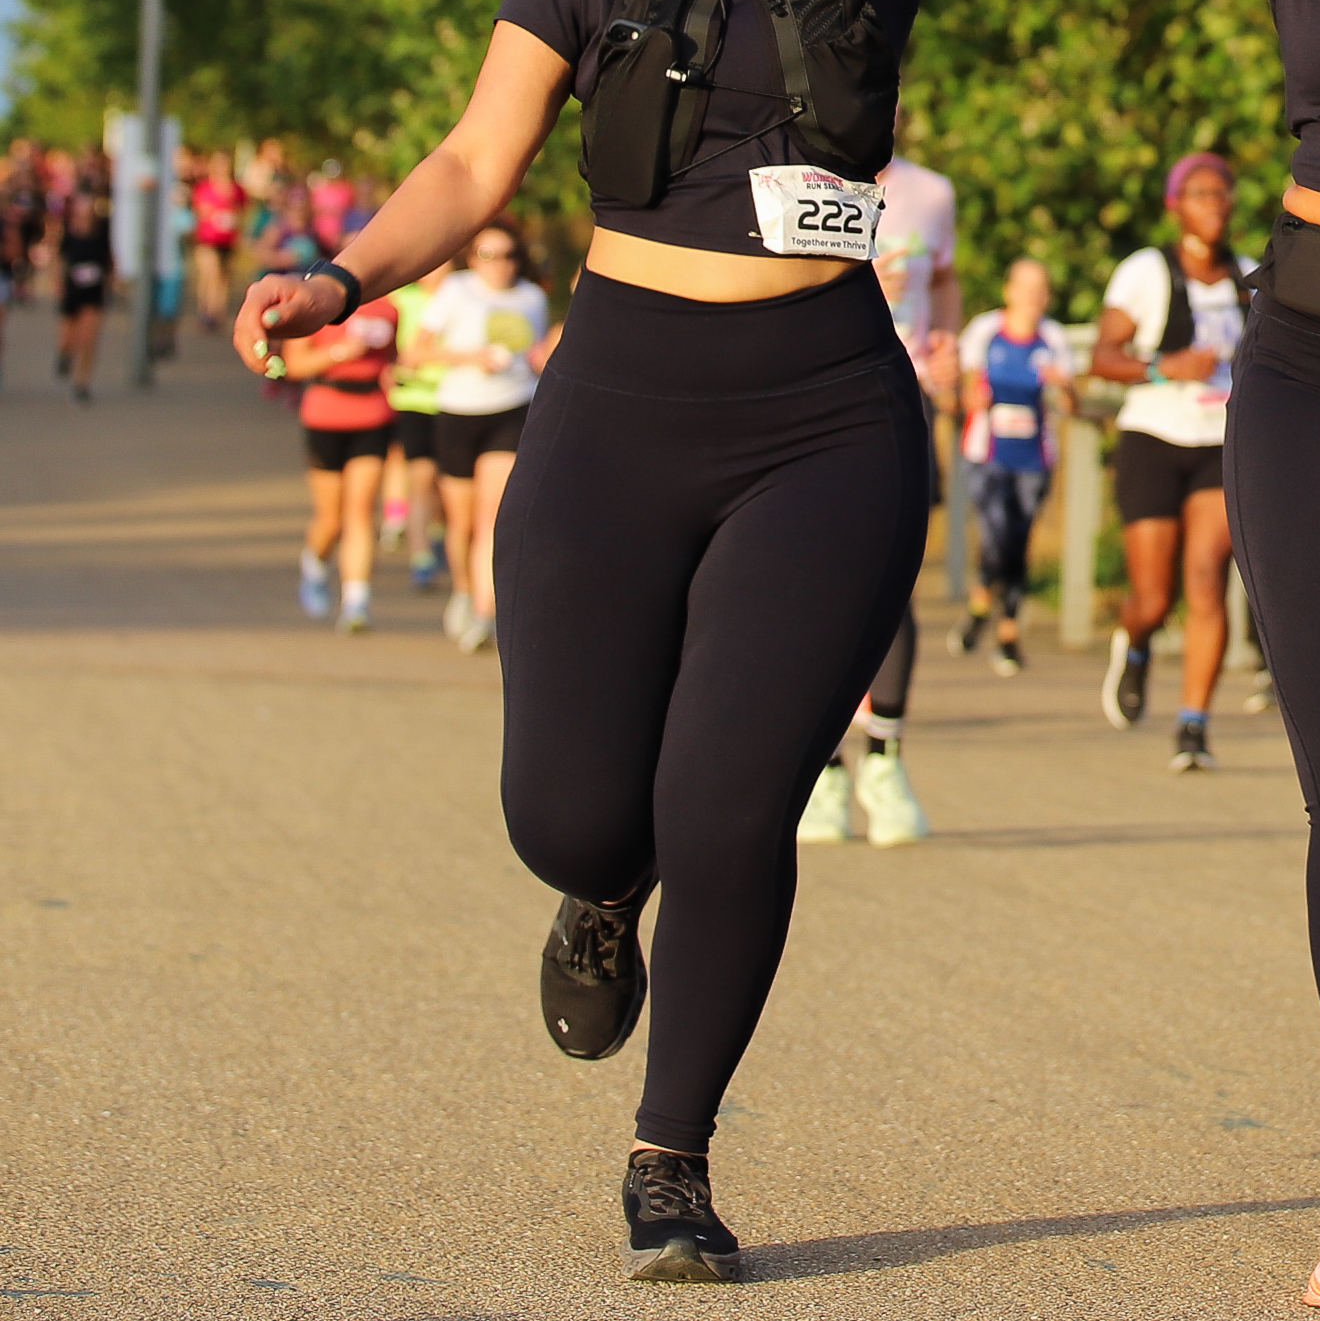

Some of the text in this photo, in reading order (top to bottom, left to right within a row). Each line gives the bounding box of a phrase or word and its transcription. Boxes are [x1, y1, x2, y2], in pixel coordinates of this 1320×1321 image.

[797, 199, 863, 234] 222
[791, 237, 867, 250] Together we Thrive
